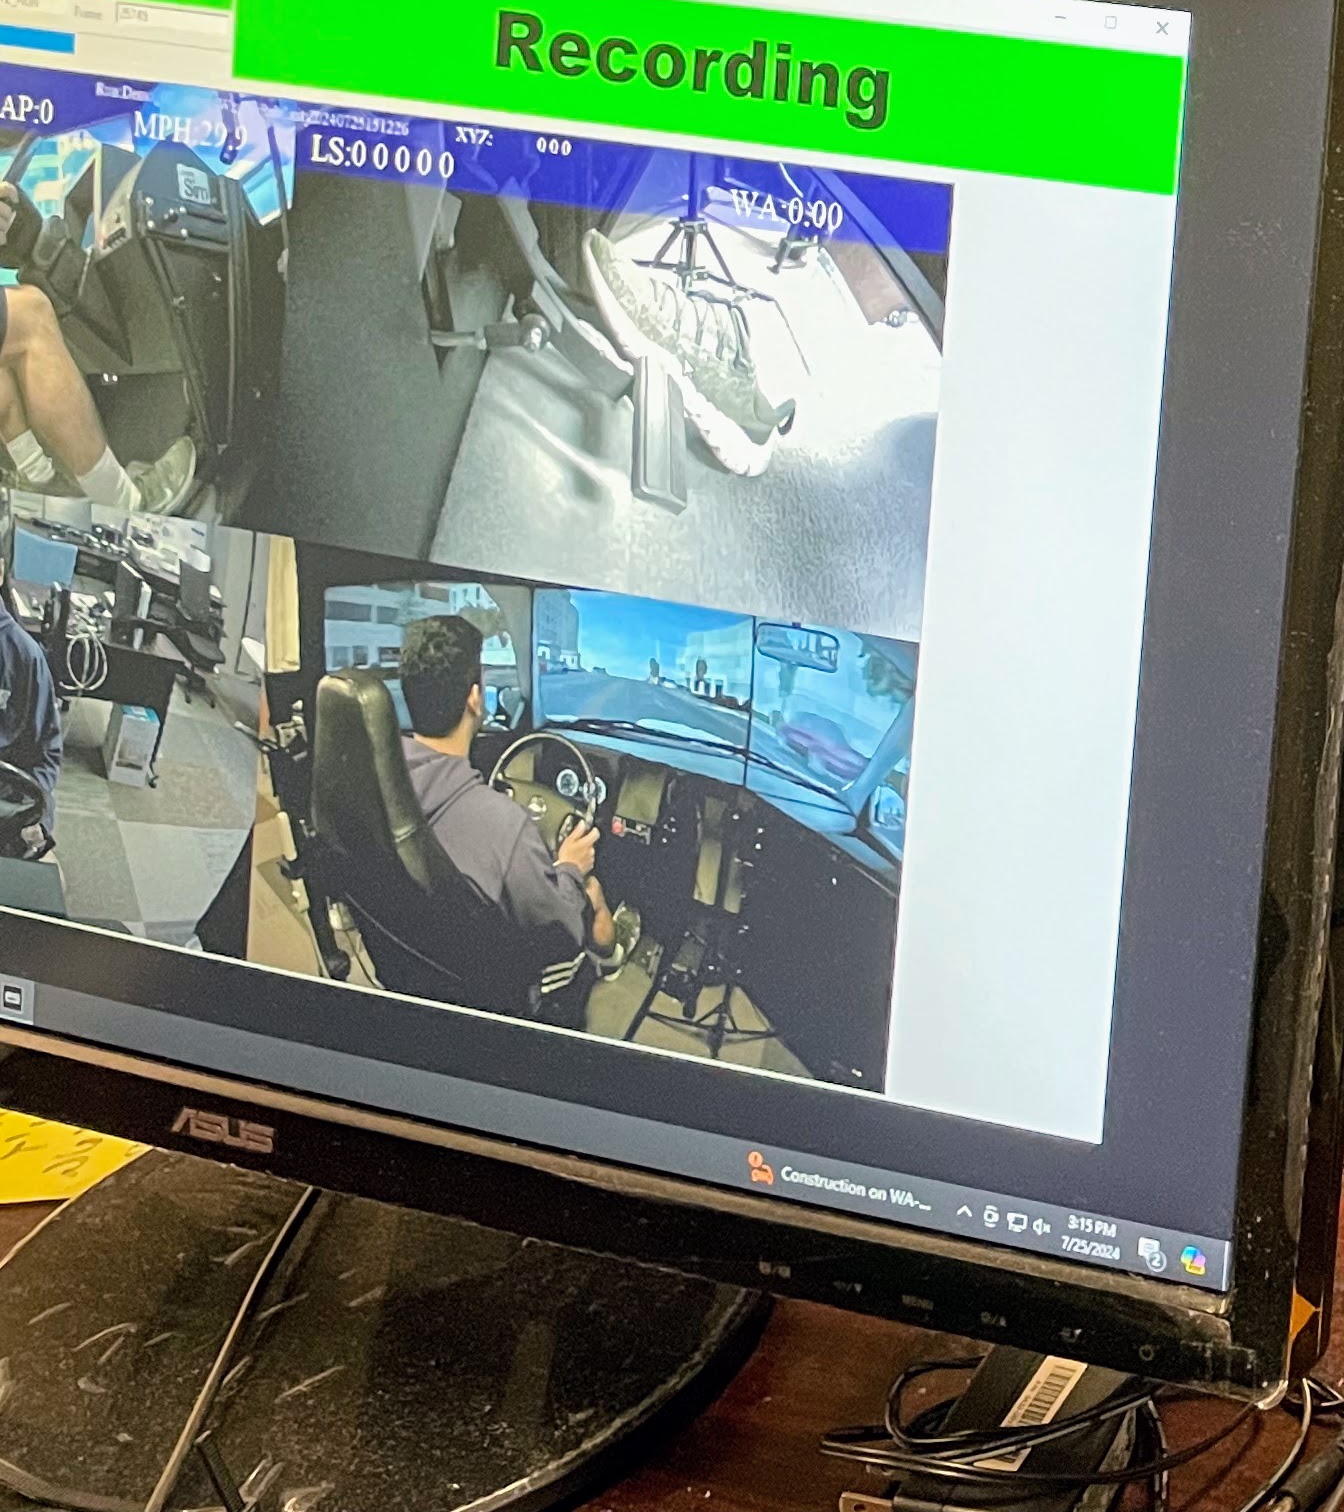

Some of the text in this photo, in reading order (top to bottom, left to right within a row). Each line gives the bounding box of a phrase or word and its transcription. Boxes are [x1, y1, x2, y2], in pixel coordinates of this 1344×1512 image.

[496, 9, 890, 130] Recording
[133, 109, 247, 148] MPH:29.9
[455, 126, 493, 146] XYZ:
[730, 187, 844, 234] WA:0.00
[171, 1107, 275, 1154] ASUS
[781, 1166, 865, 1197] Construction
[867, 1185, 886, 1200] on
[1067, 1215, 1116, 1238] 3:15 PM
[1061, 1234, 1120, 1261] 7/25/2024
